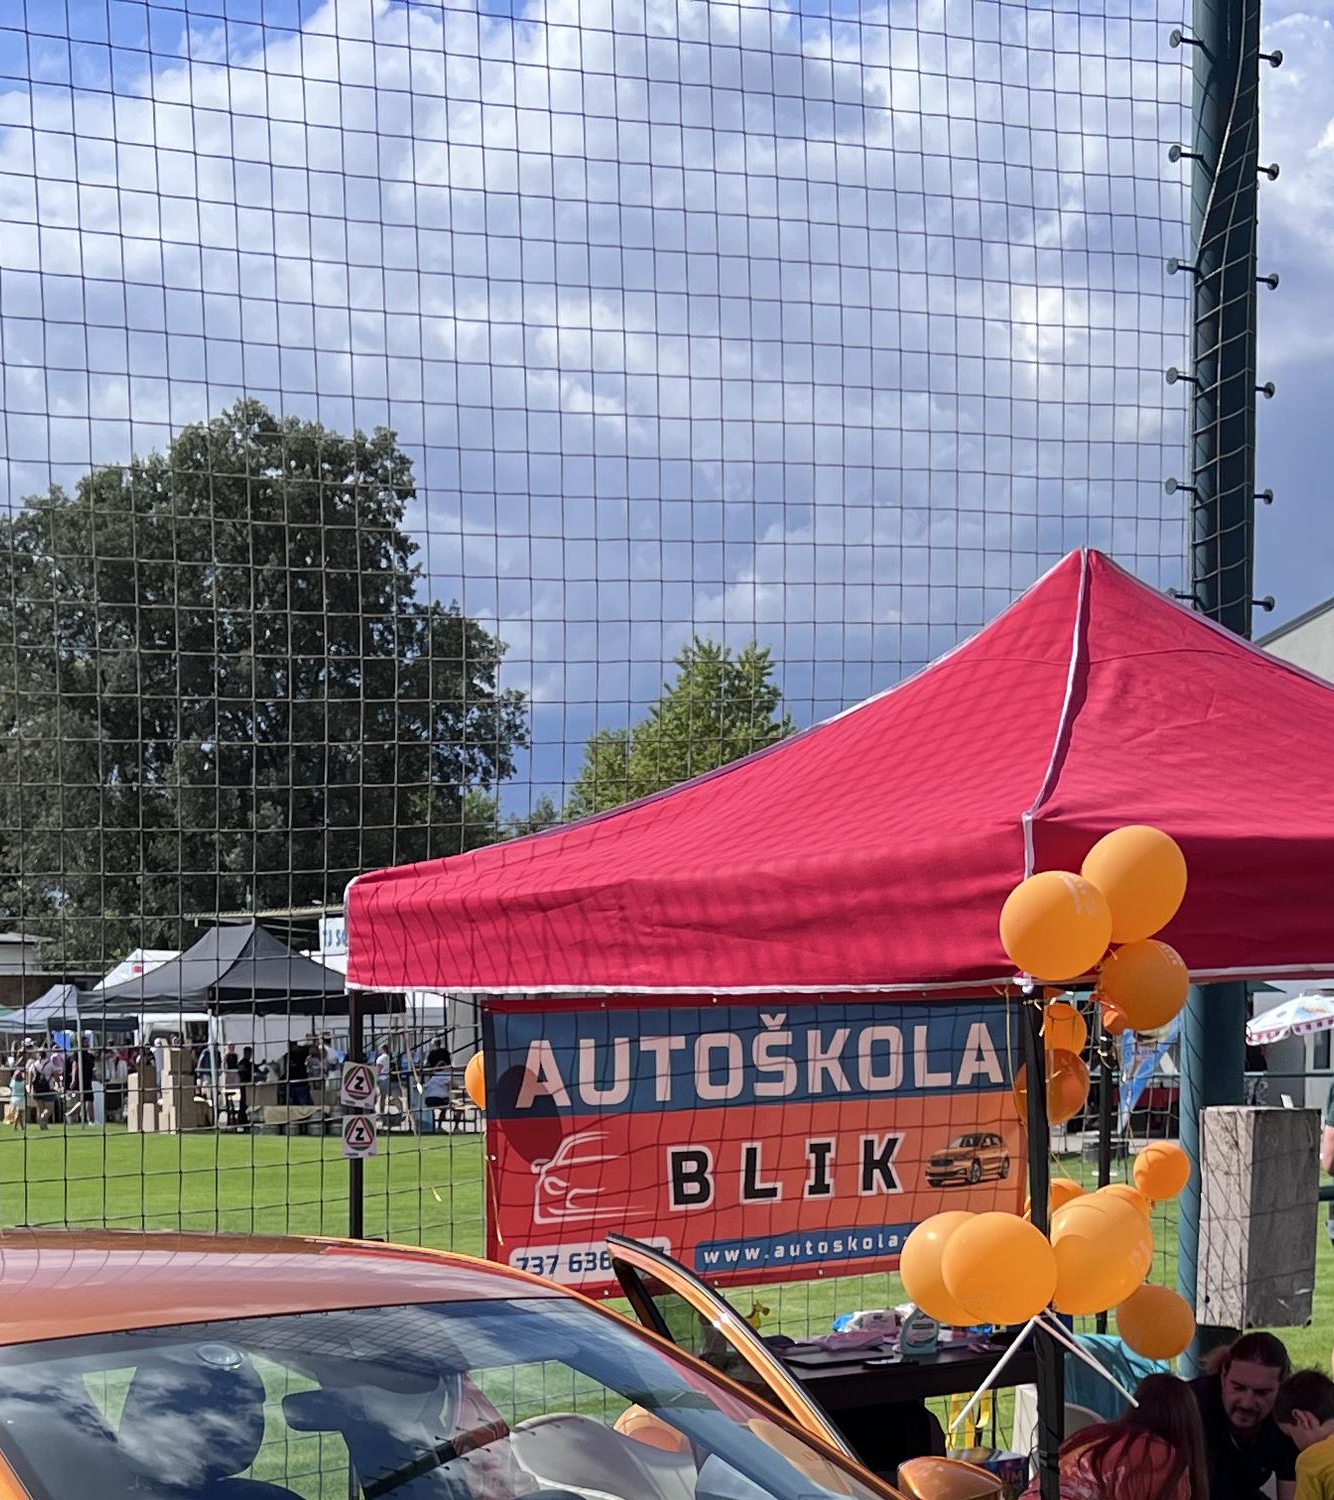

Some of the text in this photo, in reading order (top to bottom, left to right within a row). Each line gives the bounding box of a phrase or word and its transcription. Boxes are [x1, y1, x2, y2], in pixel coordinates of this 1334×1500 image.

[514, 1013, 1004, 1109] AUTOŠKOLA
[667, 1132, 905, 1212] BLIK
[516, 1254, 559, 1277] 737
[703, 1233, 909, 1264] www.autoskola-
